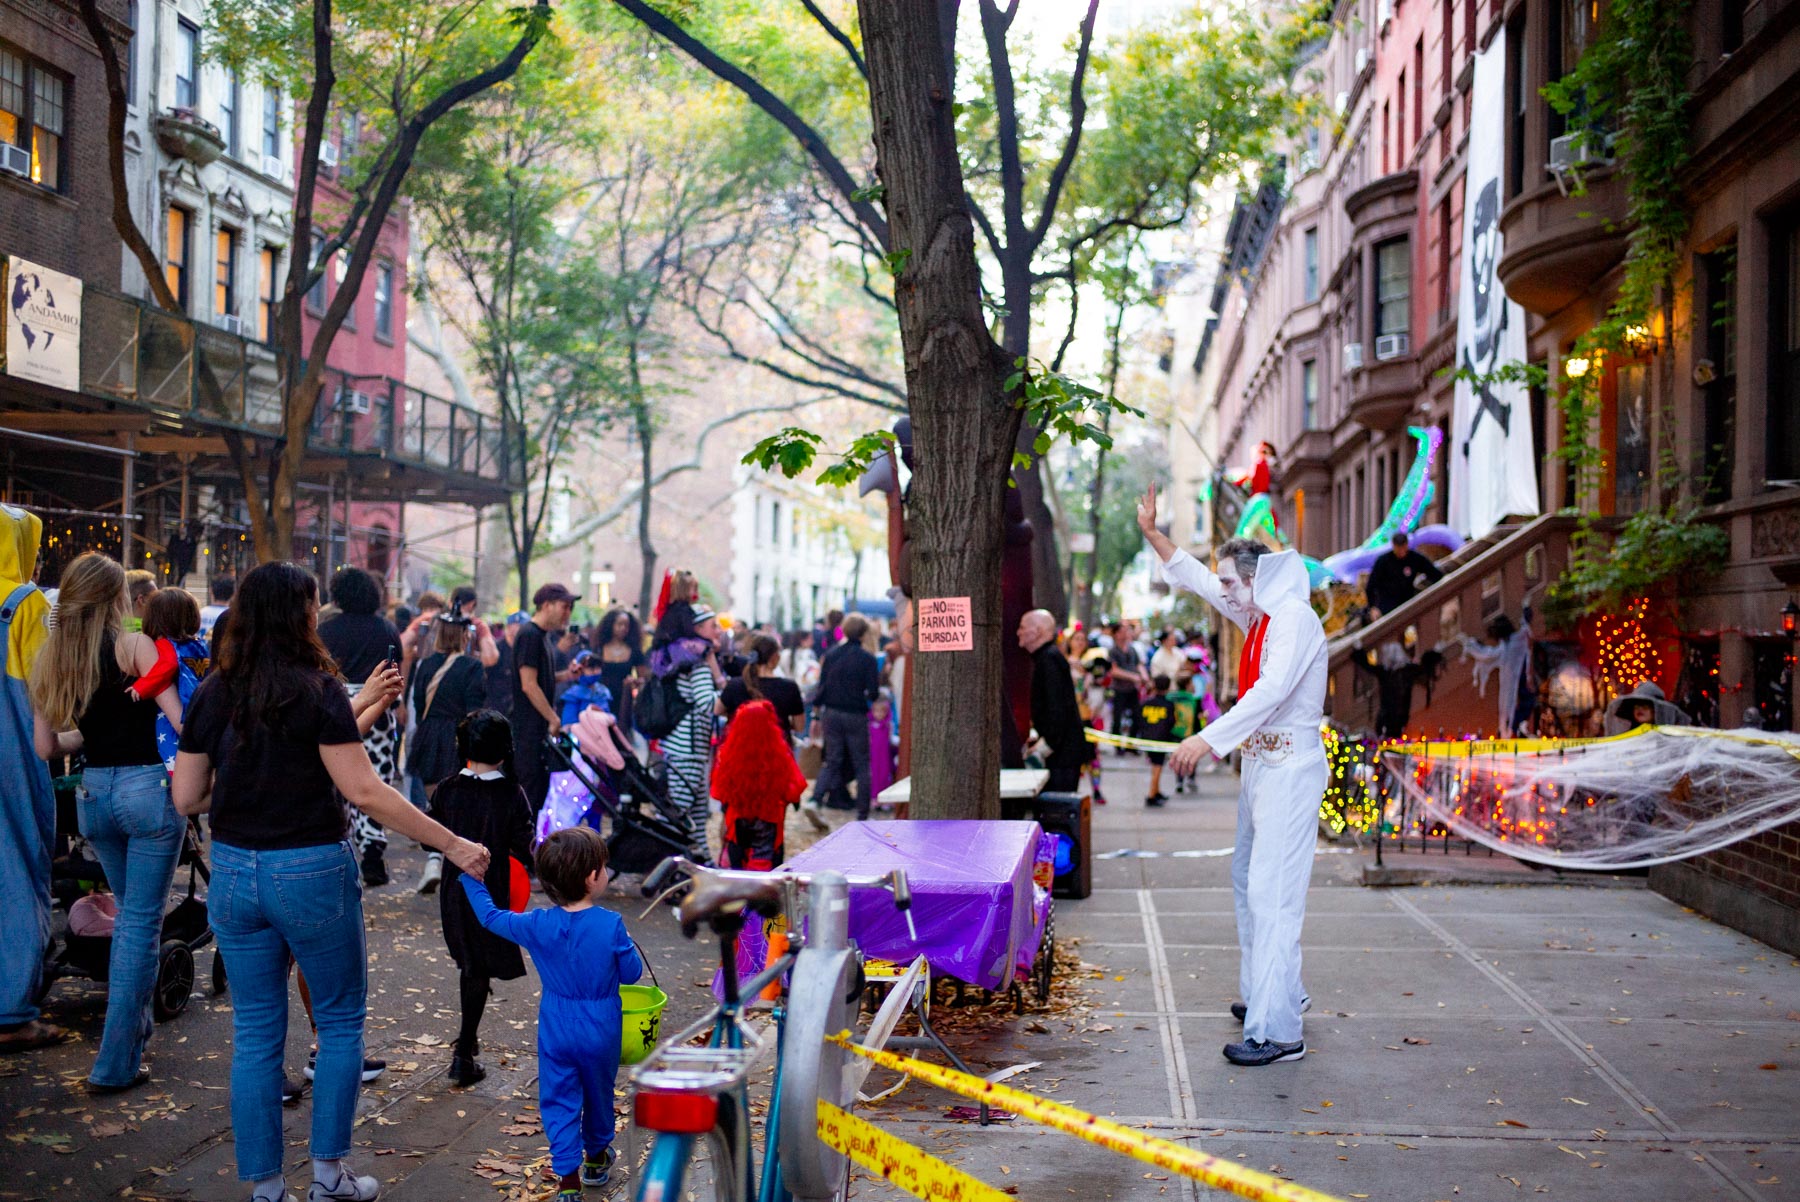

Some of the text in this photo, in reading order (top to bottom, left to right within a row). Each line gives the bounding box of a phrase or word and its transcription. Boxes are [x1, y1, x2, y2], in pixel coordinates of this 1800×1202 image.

[29, 303, 79, 326] ANDAMIO
[933, 601, 946, 613] NO
[921, 615, 965, 628] PARKING
[921, 631, 967, 643] THURSDAY
[827, 1125, 839, 1138] DO
[850, 1136, 878, 1160] ENTER
[881, 1153, 900, 1171] NOT
[904, 1166, 917, 1181] DO
